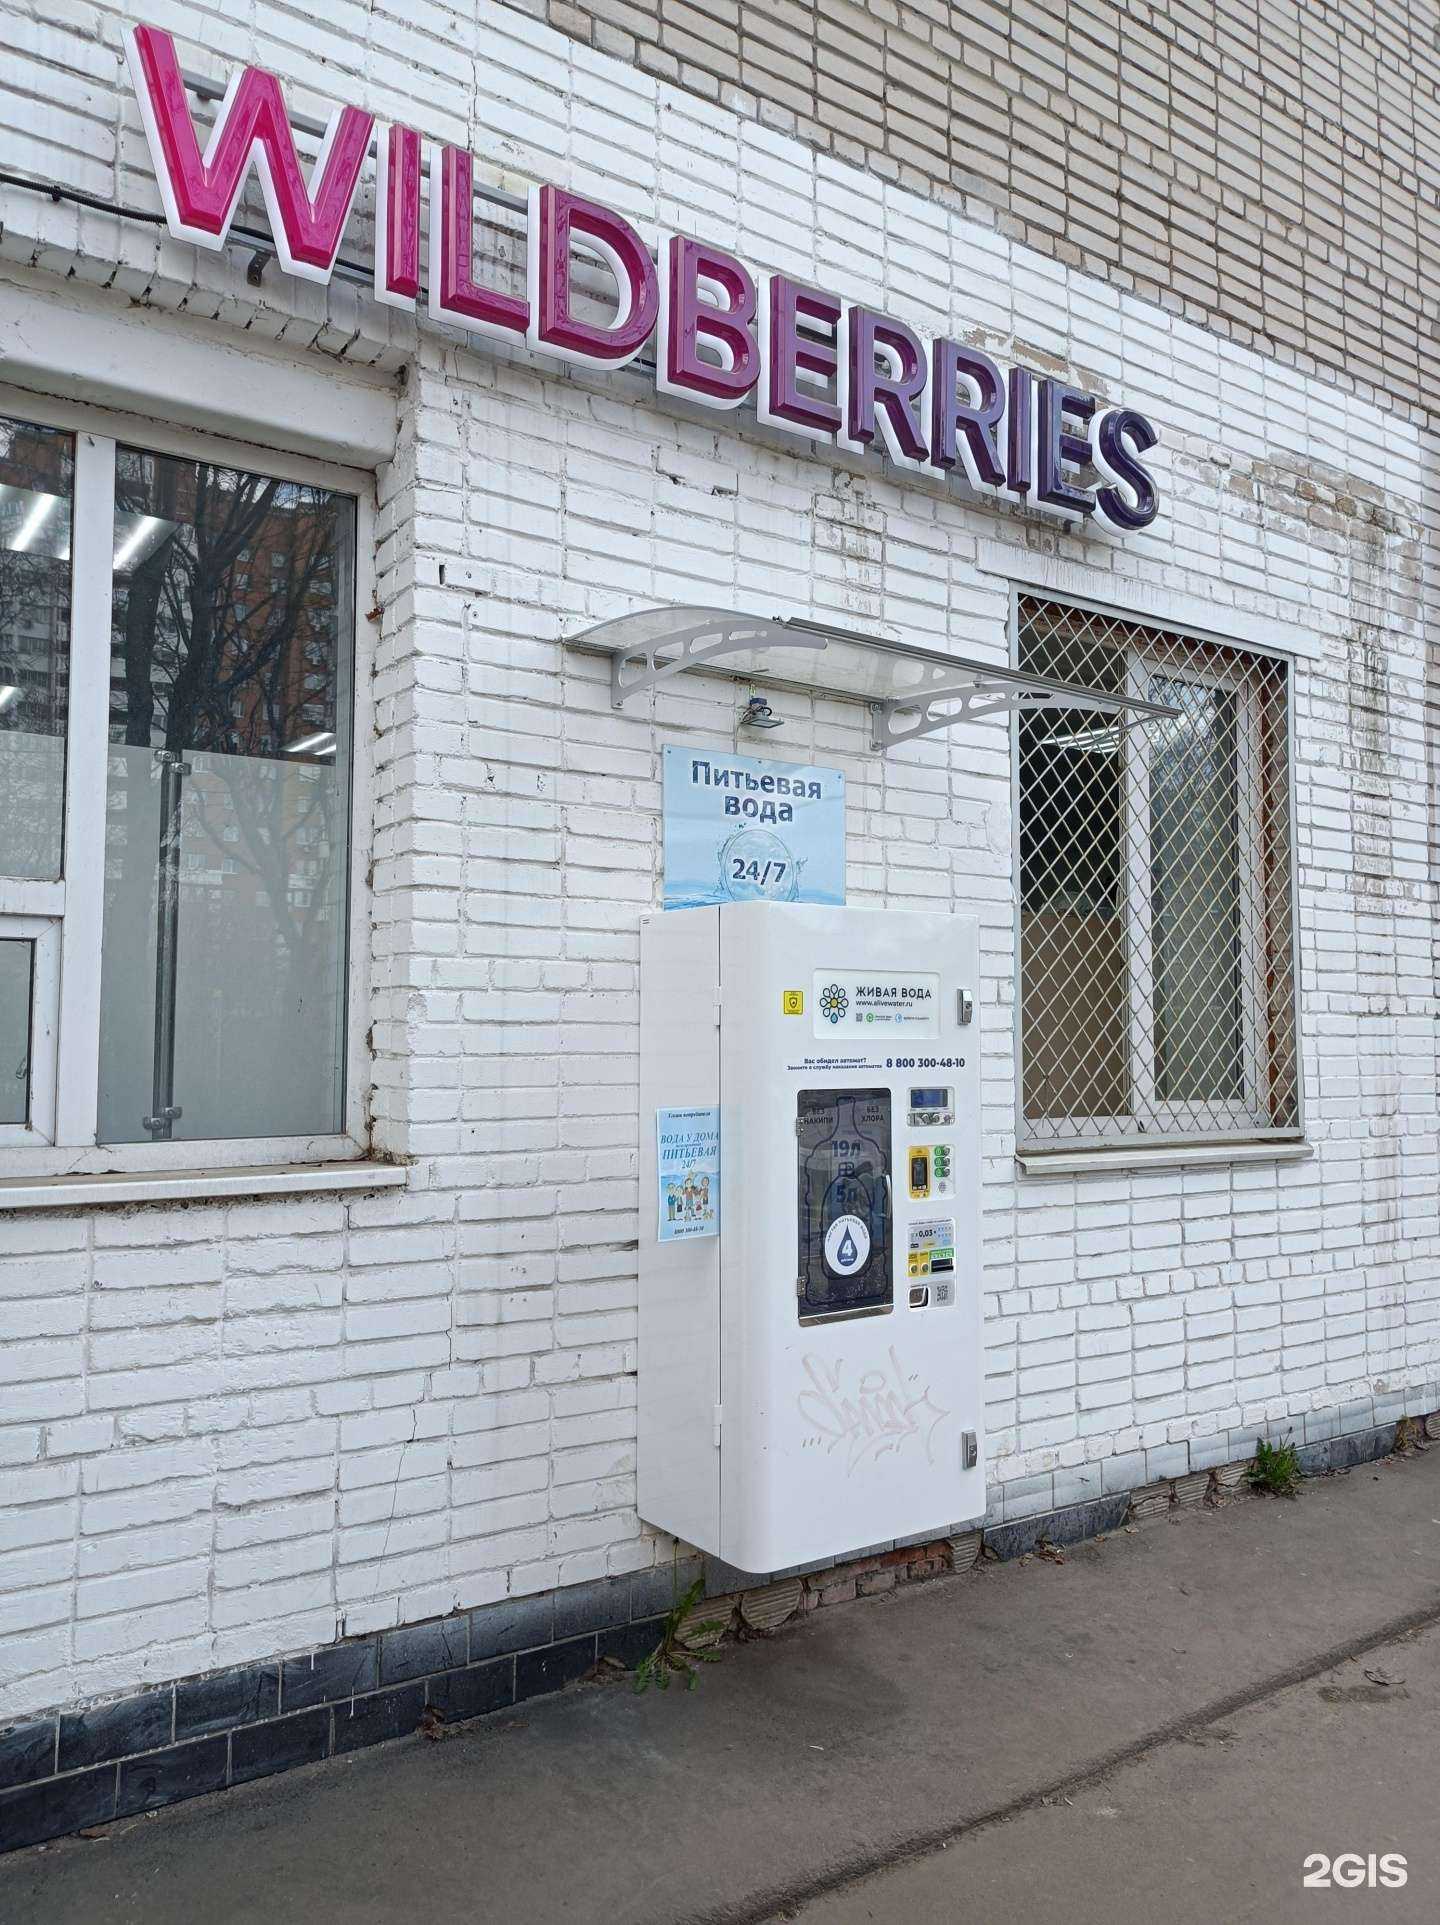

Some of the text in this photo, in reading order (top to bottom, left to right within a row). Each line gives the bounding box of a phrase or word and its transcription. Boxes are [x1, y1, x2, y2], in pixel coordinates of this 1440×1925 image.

[122, 23, 1159, 536] WILDBERRIES
[692, 760, 822, 799] Питьевая
[724, 796, 793, 824] вода
[732, 858, 786, 885] 24/7
[855, 986, 932, 1000] ЖИВАЯ ВОДА
[855, 1000, 913, 1008] www.alivewater.ru
[886, 1058, 892, 1068] 8
[895, 1058, 915, 1068] 800
